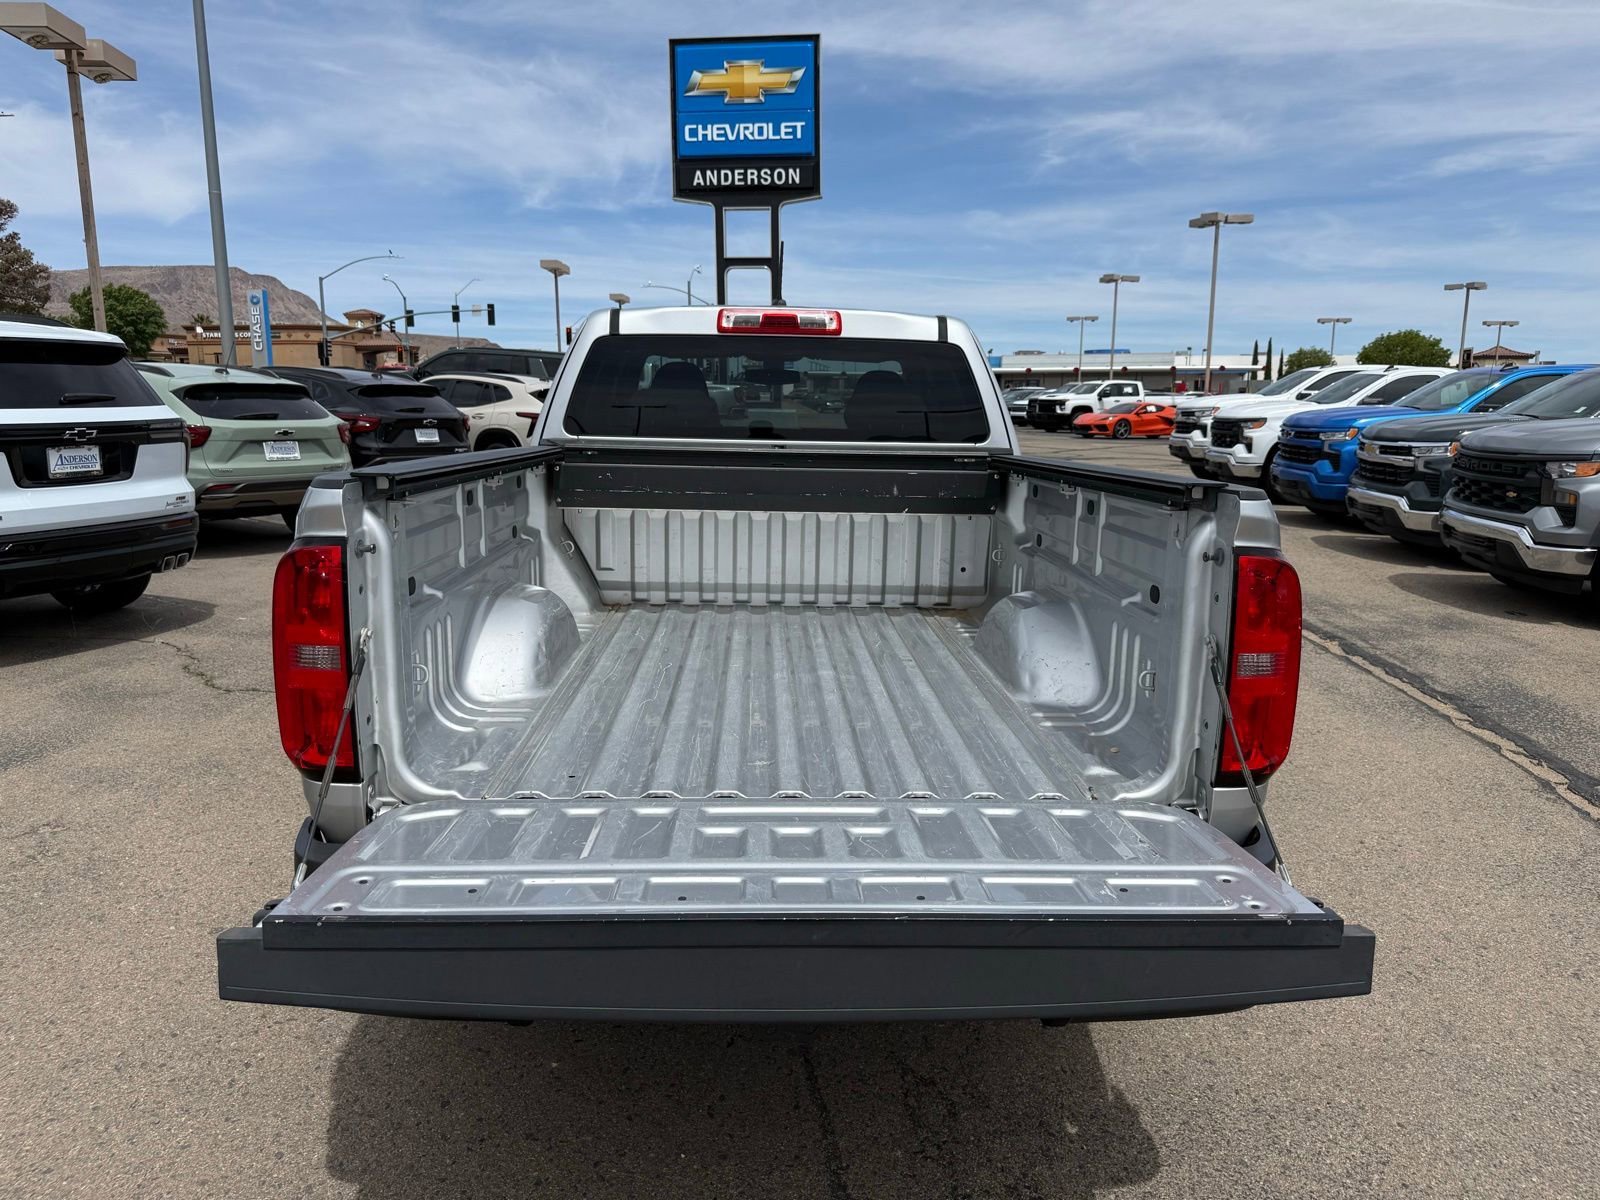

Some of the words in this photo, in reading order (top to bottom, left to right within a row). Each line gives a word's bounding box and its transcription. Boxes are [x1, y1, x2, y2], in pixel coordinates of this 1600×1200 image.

[684, 122, 806, 142] CHEVROLET
[693, 168, 800, 187] ANDERSON
[251, 307, 263, 351] CHASE
[53, 454, 98, 471] ANDERSON
